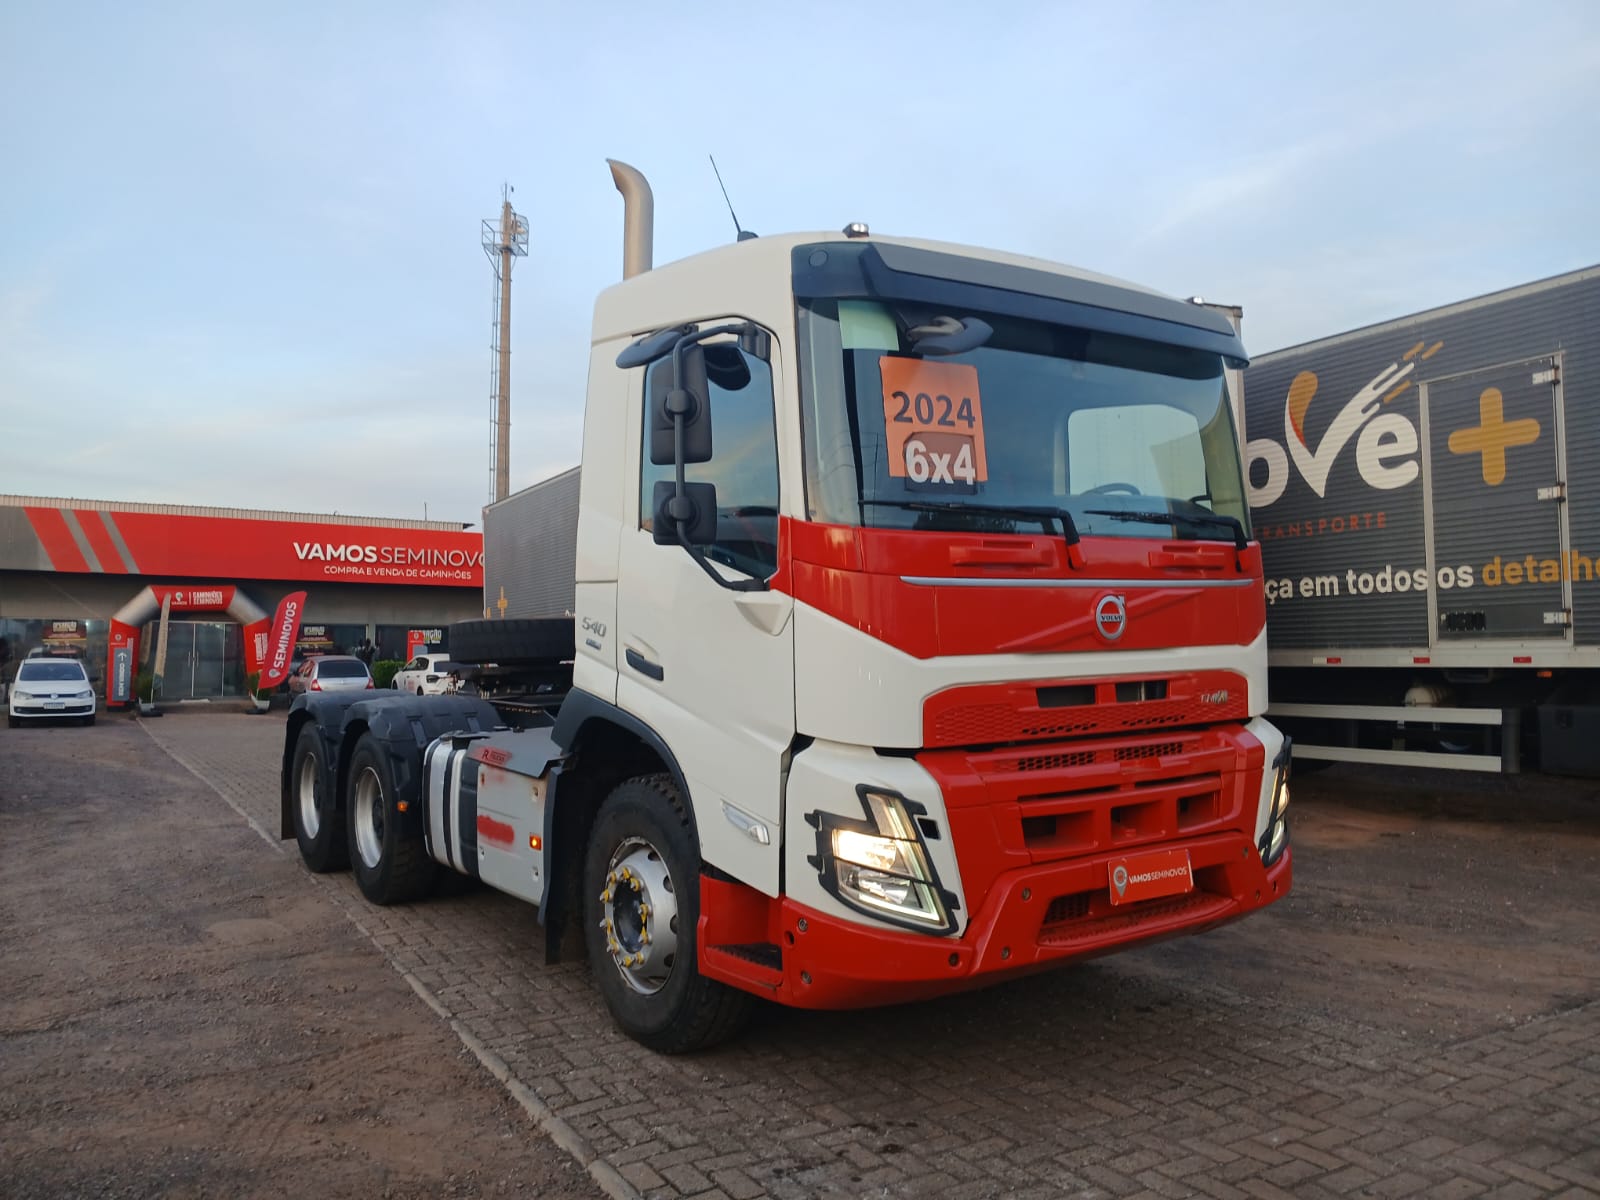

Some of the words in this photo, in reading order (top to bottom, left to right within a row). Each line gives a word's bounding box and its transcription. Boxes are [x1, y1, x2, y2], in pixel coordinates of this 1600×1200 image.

[891, 391, 976, 429] 2024
[905, 440, 976, 485] 6x4
[324, 565, 366, 576] COMPRA
[366, 567, 373, 576] E
[373, 567, 404, 577] VENDA
[406, 568, 418, 577] DE
[419, 569, 472, 579] CAMINHÕES
[1264, 578, 1294, 605] ça
[1299, 575, 1340, 598] em
[1346, 564, 1428, 595] todos
[1437, 565, 1474, 589] os
[1482, 549, 1600, 587] detalh
[273, 601, 297, 668] SEMINOVOS
[582, 616, 607, 638] 540
